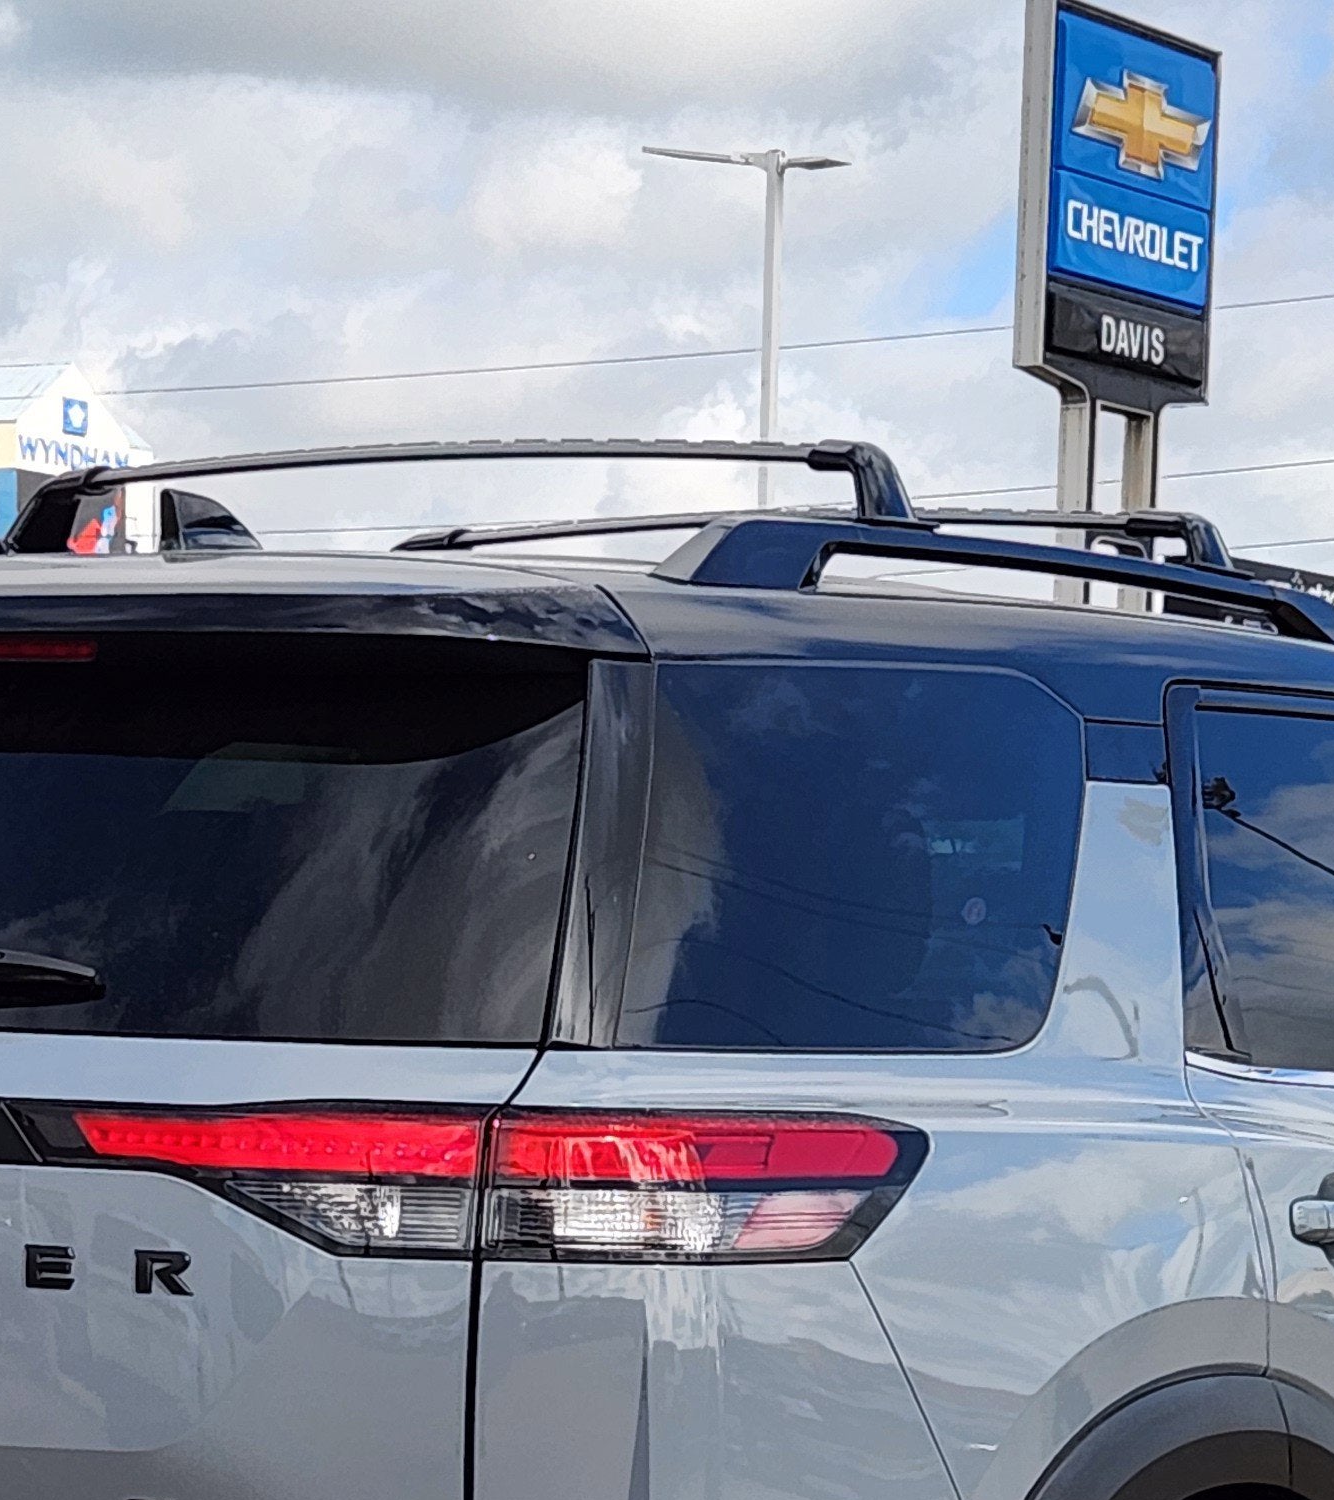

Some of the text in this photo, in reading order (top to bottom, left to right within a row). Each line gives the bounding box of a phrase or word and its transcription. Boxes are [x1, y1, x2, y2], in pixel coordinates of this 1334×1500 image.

[1067, 199, 1204, 272] CHEVROLET
[1100, 314, 1165, 366] DAVIS
[18, 434, 129, 471] WYNDHAM
